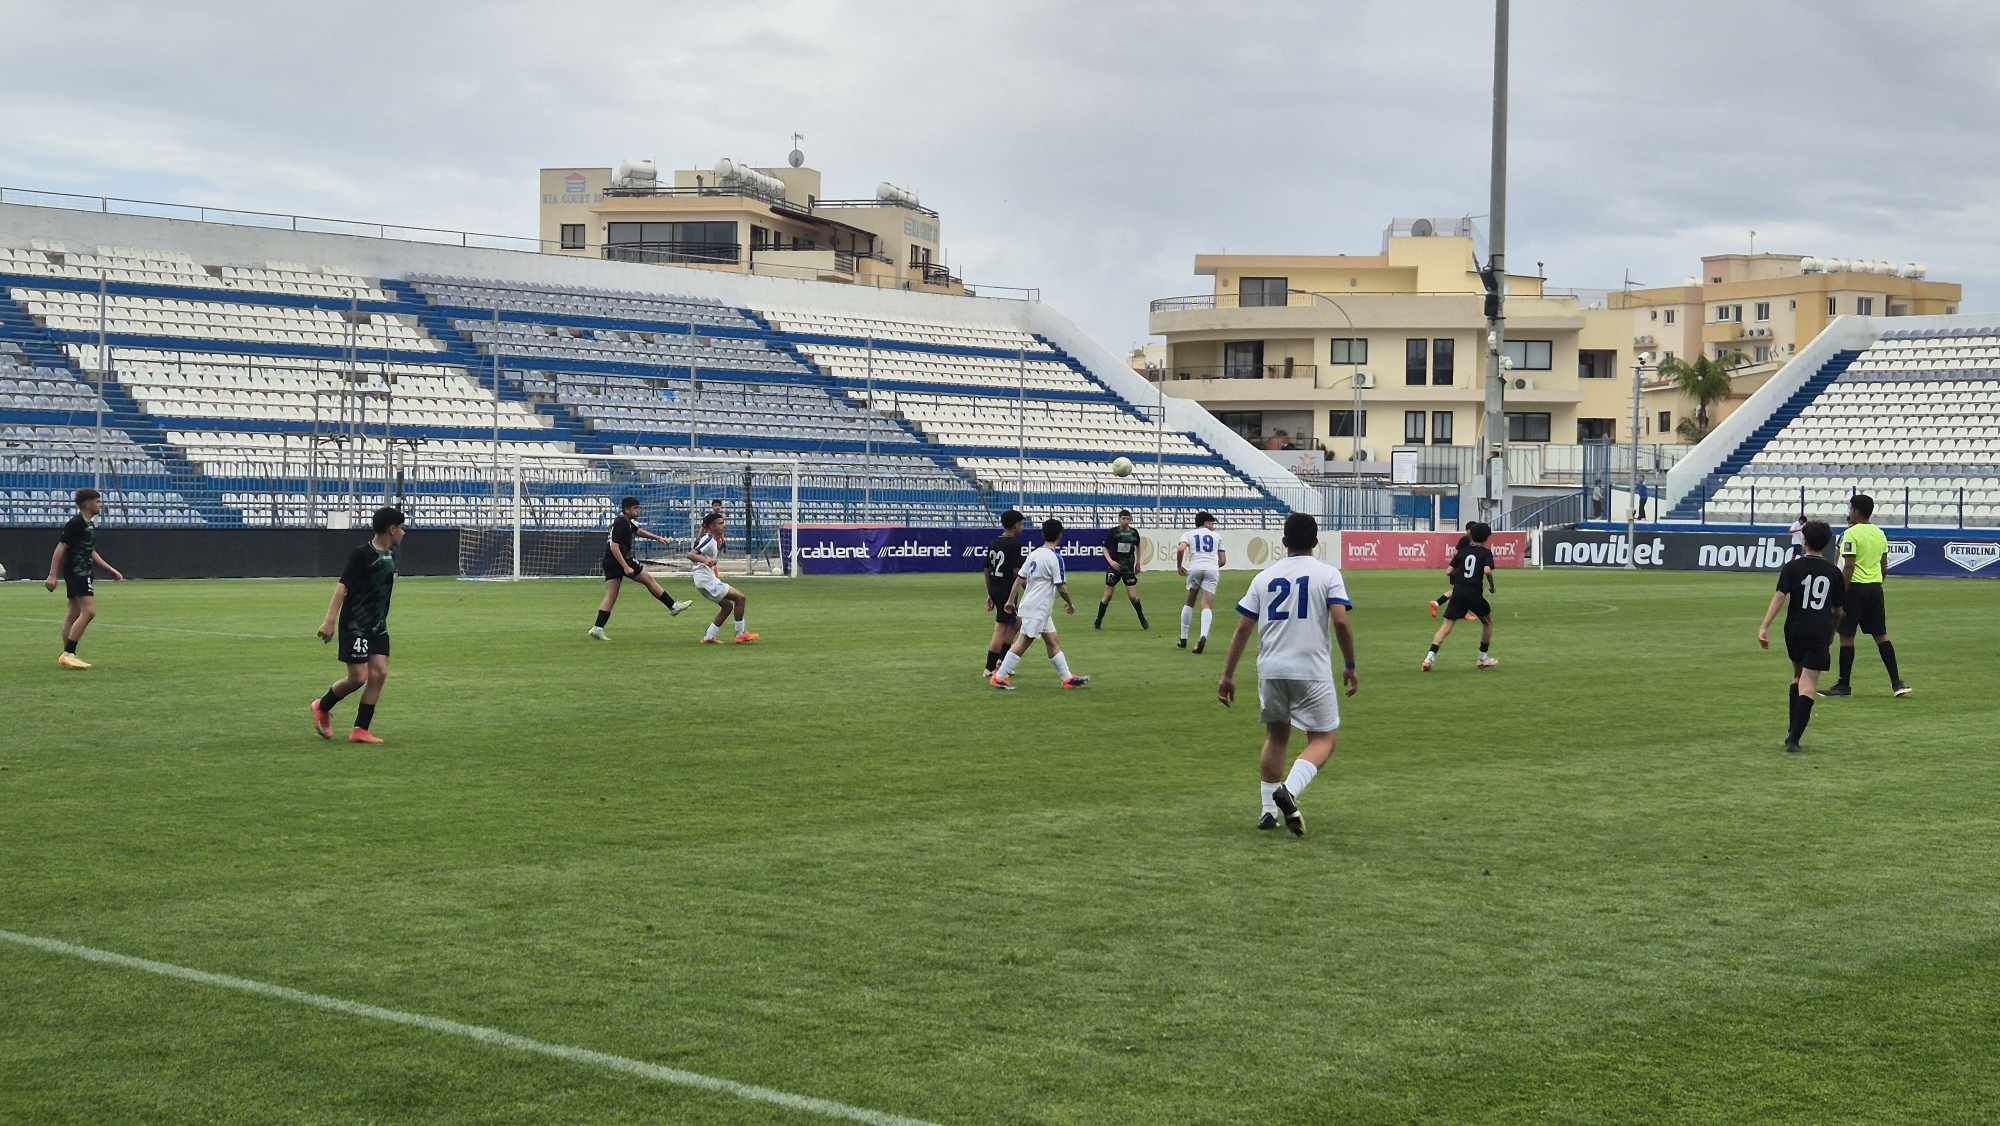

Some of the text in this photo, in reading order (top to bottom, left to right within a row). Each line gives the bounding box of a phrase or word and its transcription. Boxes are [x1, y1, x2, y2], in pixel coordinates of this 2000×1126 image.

[801, 541, 870, 559] cablenet
[887, 540, 951, 557] cablenet
[1055, 540, 1104, 556] ablene
[1193, 535, 1214, 552] 19
[1348, 543, 1377, 556] IronFX
[1398, 543, 1426, 557] IronFX
[1554, 534, 1665, 566] novibet
[1950, 546, 1996, 556] PETROLINA
[1698, 537, 1794, 568] novib
[1463, 554, 1477, 579] 9
[1267, 575, 1310, 621] 21
[1800, 574, 1831, 610] 19
[353, 637, 368, 653] 43
